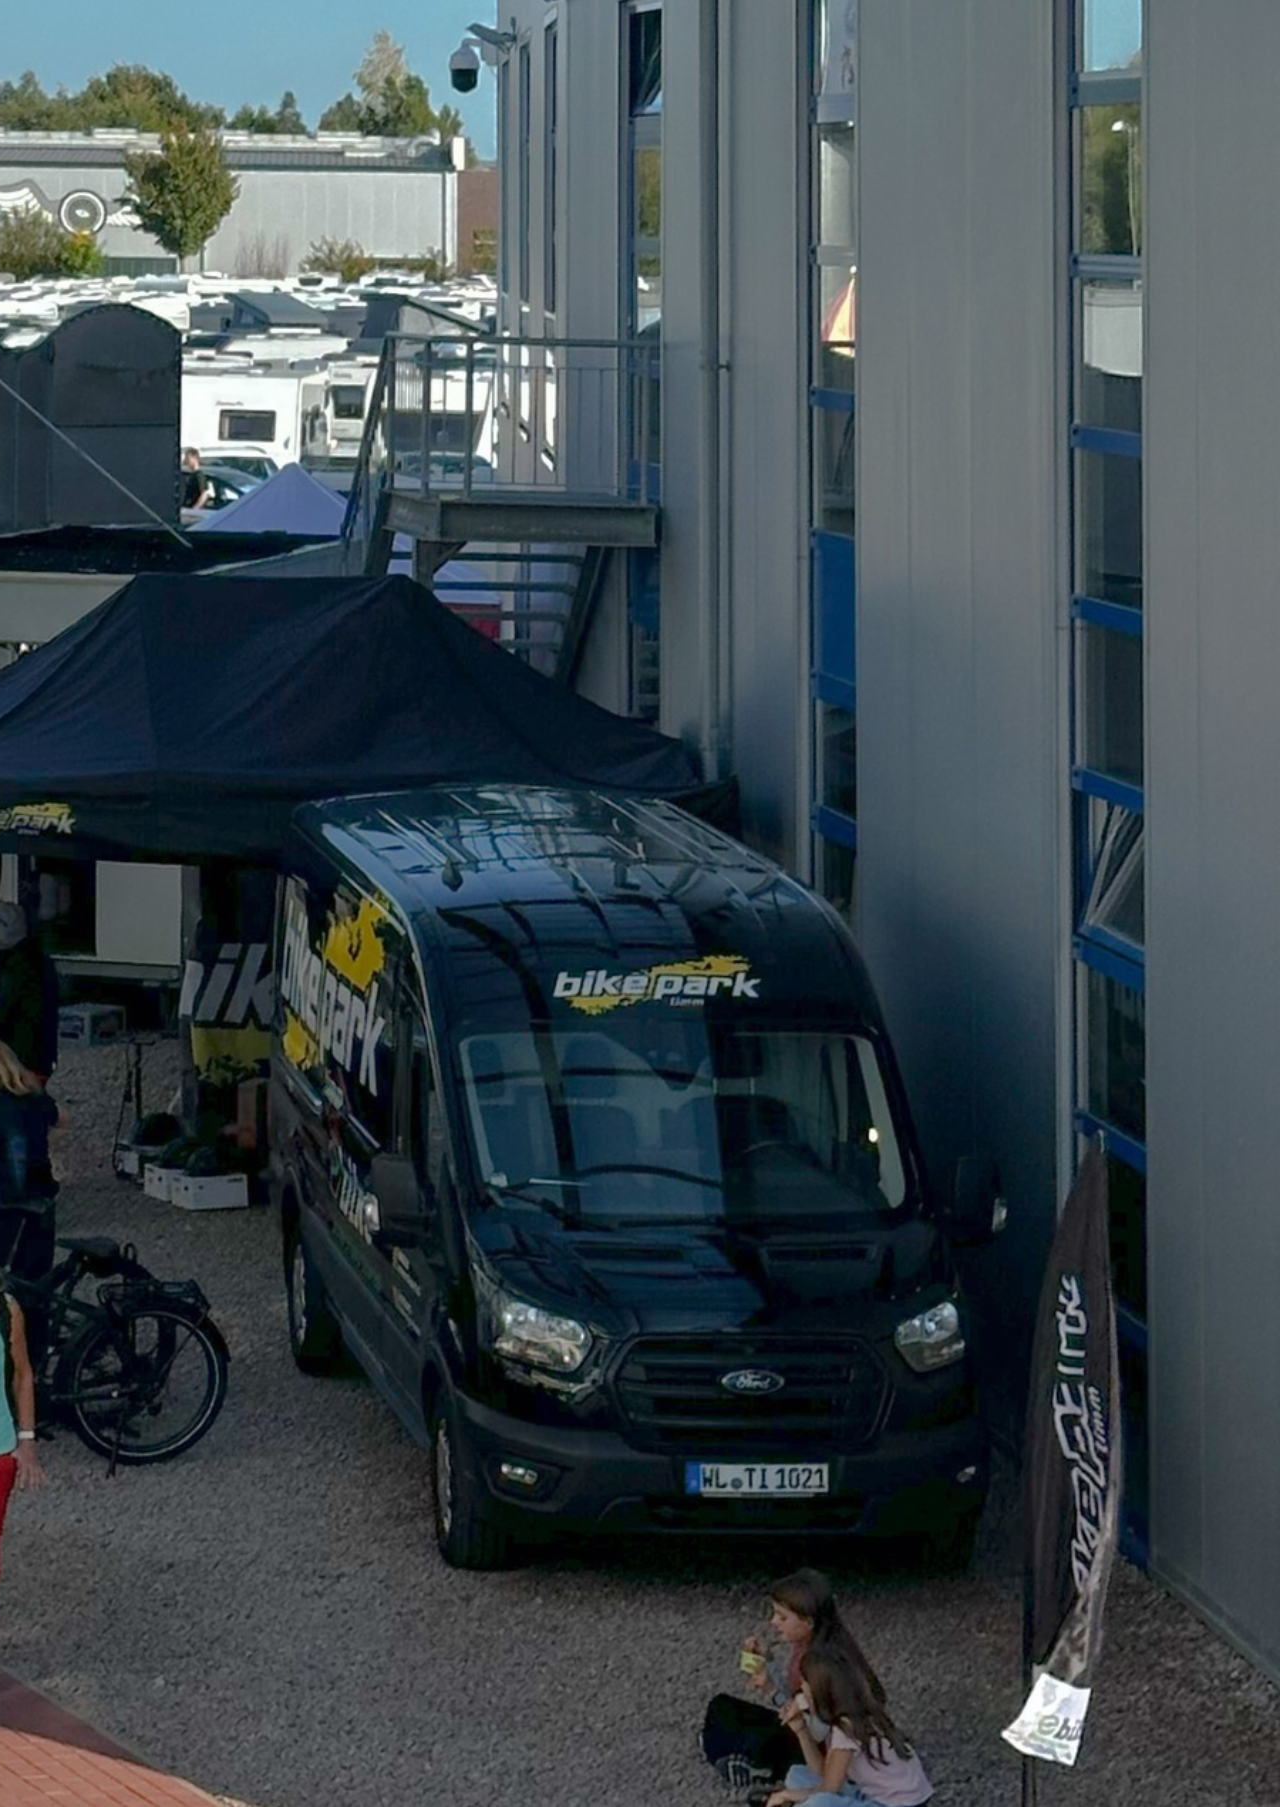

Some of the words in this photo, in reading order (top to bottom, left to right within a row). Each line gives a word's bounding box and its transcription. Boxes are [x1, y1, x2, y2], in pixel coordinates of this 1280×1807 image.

[735, 1372, 771, 1389] Ford
[701, 1467, 728, 1490] WL
[744, 1467, 769, 1490] TI
[775, 1467, 826, 1490] 1021
